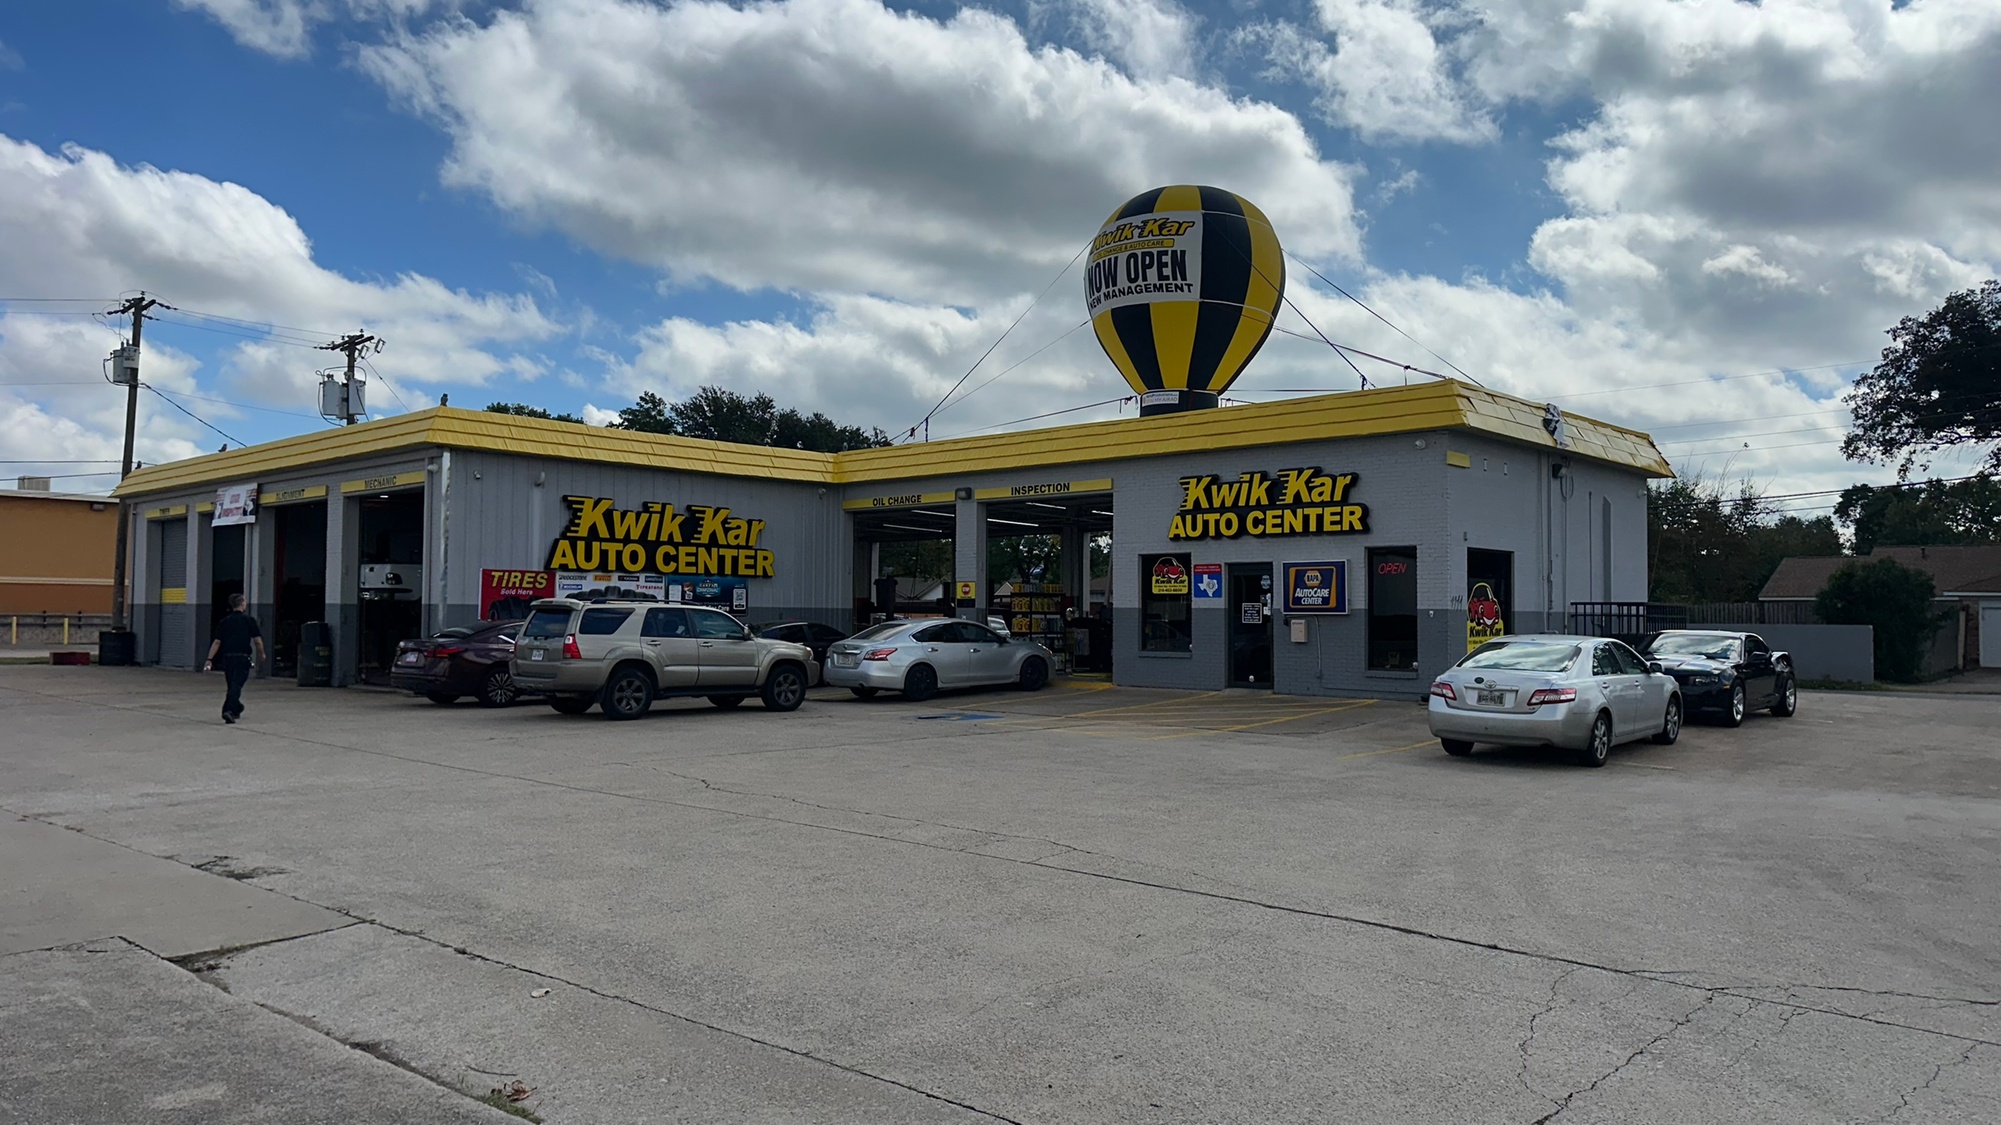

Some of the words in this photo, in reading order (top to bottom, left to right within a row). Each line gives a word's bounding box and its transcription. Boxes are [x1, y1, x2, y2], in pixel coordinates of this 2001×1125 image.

[1138, 218, 1195, 238] Kar
[1088, 256, 1119, 299] NOW
[1126, 249, 1188, 284] OPEN
[1090, 294, 1102, 310] NEW
[1103, 283, 1194, 302] MANAGEMENT
[365, 476, 397, 489] MECHANIC
[1010, 482, 1070, 496] INSPECTION
[1178, 471, 1271, 511] Kwik
[1276, 468, 1352, 505] Kar
[872, 496, 886, 507] OIL
[887, 494, 922, 506] CHANGE
[566, 496, 687, 543] Kwik
[690, 505, 766, 547] Kar
[1168, 512, 1239, 539] AUTO
[1246, 505, 1363, 535] CENTER
[550, 539, 646, 572] AUTO
[655, 545, 776, 577] CENTER
[1378, 562, 1407, 575] OPEN
[491, 571, 549, 589] TIRES
[1306, 574, 1319, 583] NAPA
[500, 588, 517, 596] Sold
[517, 588, 534, 596] Here
[1301, 597, 1322, 605] CENTER
[1469, 626, 1488, 638] Kwik
[1489, 626, 1502, 637] Kar
